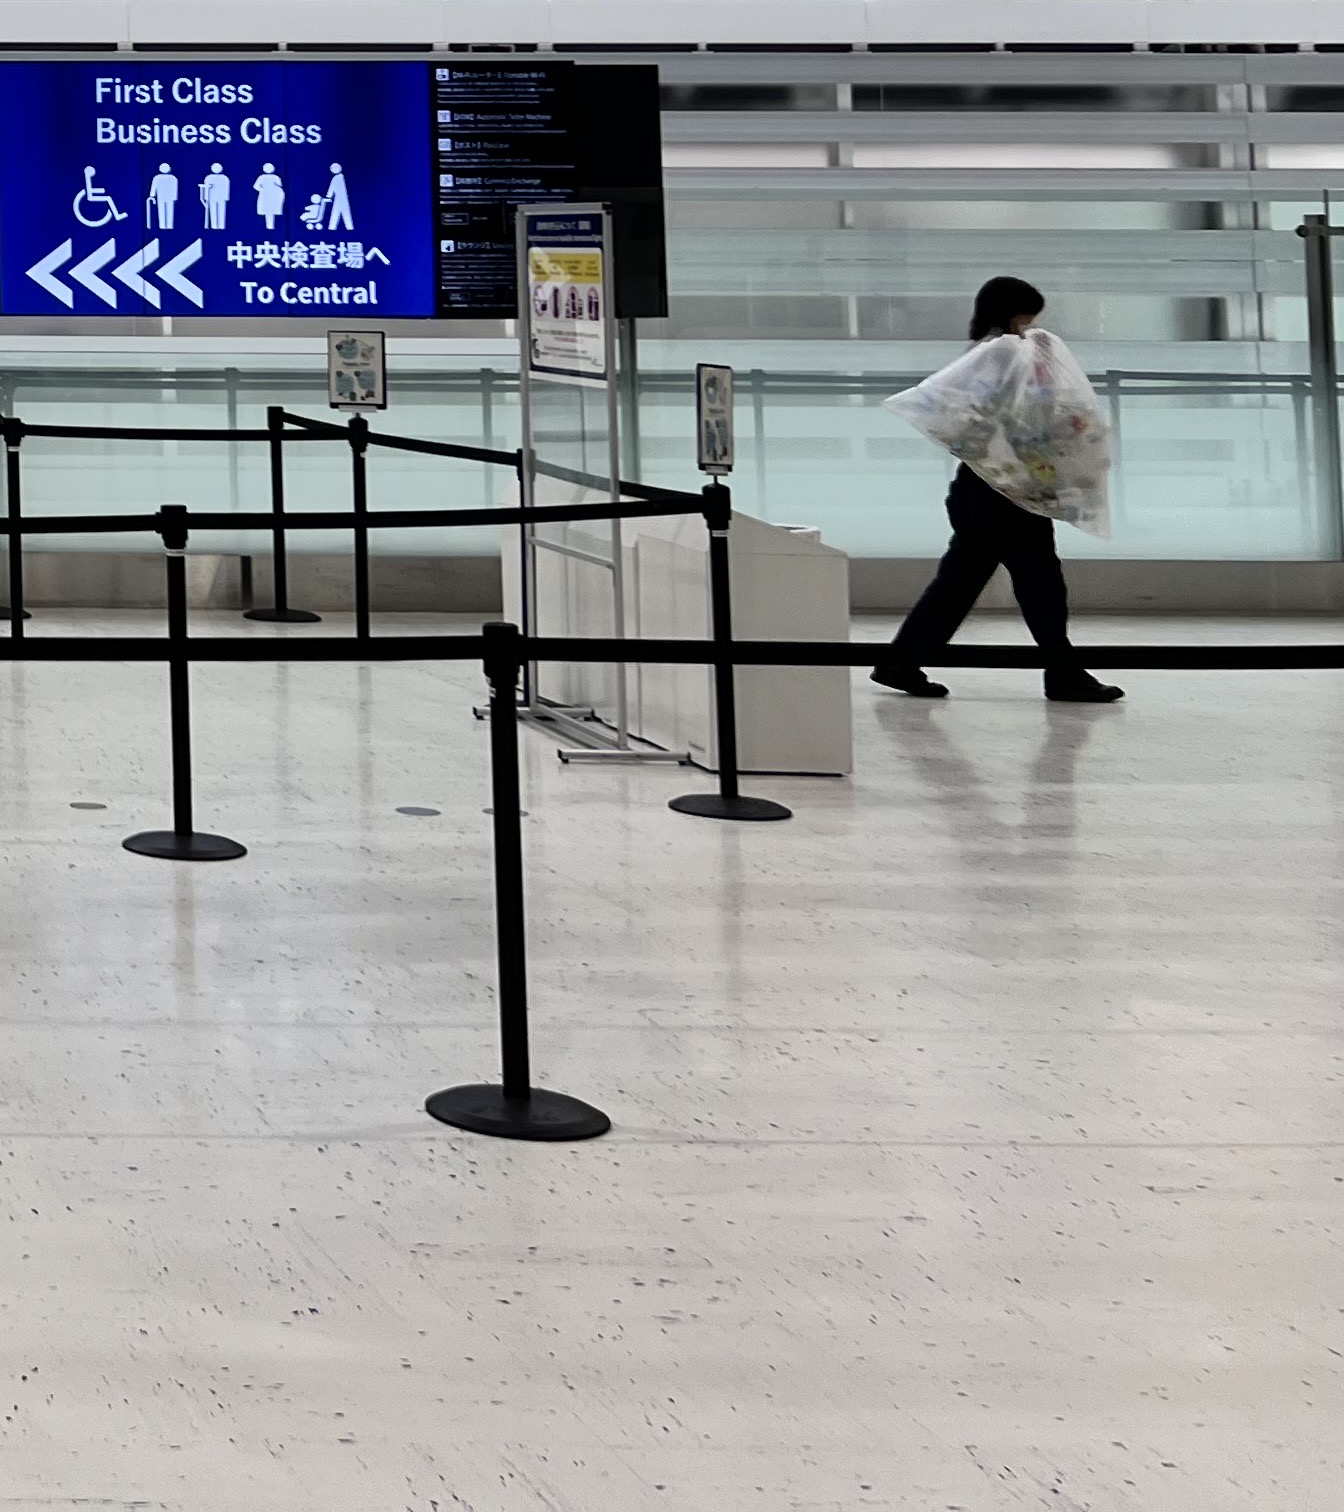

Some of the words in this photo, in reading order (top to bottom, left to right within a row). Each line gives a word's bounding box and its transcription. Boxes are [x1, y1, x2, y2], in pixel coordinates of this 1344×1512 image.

[95, 77, 164, 104] First
[171, 77, 254, 104] Class
[96, 117, 233, 145] Business
[240, 117, 322, 145] Class
[226, 240, 391, 270] 中央検査場へ
[239, 281, 275, 305] To
[279, 280, 379, 305] Central
